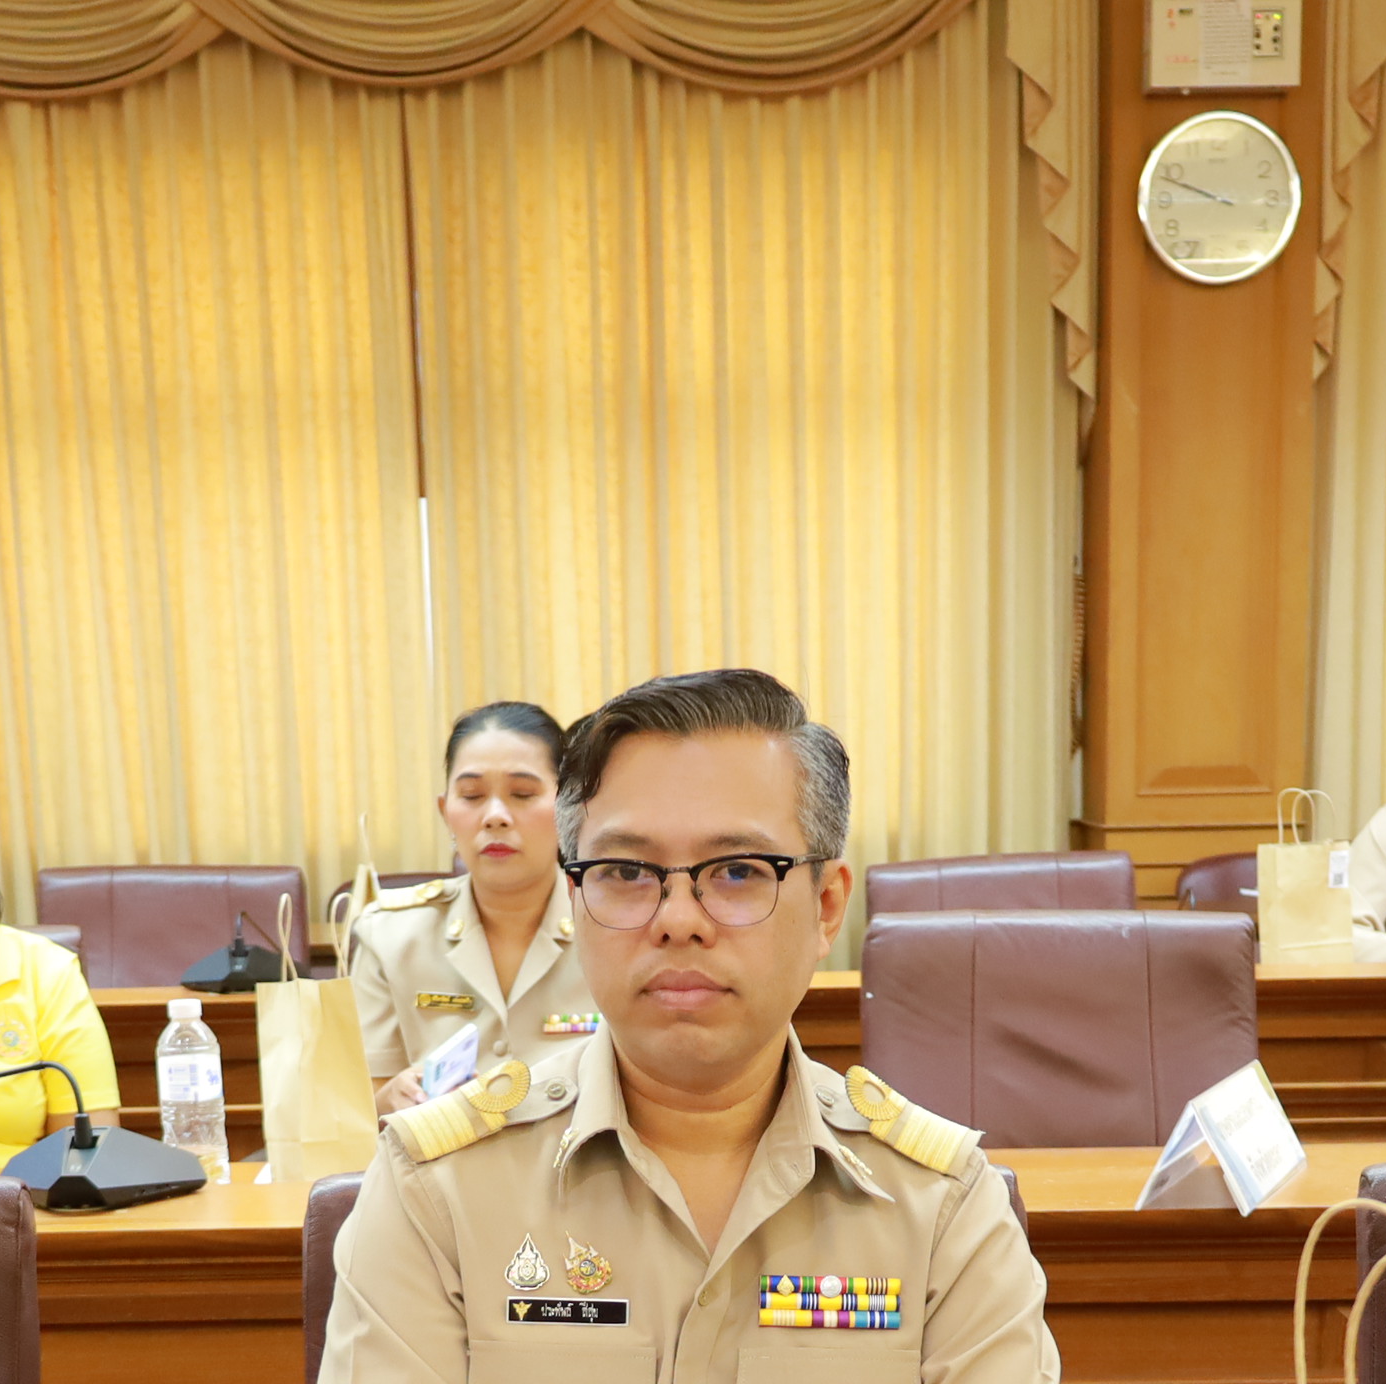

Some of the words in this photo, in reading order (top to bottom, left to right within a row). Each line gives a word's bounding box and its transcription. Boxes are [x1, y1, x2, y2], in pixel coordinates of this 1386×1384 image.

[1258, 160, 1272, 179] 2
[1158, 191, 1172, 209] 9
[1265, 190, 1279, 208] 3
[1165, 218, 1179, 237] 8
